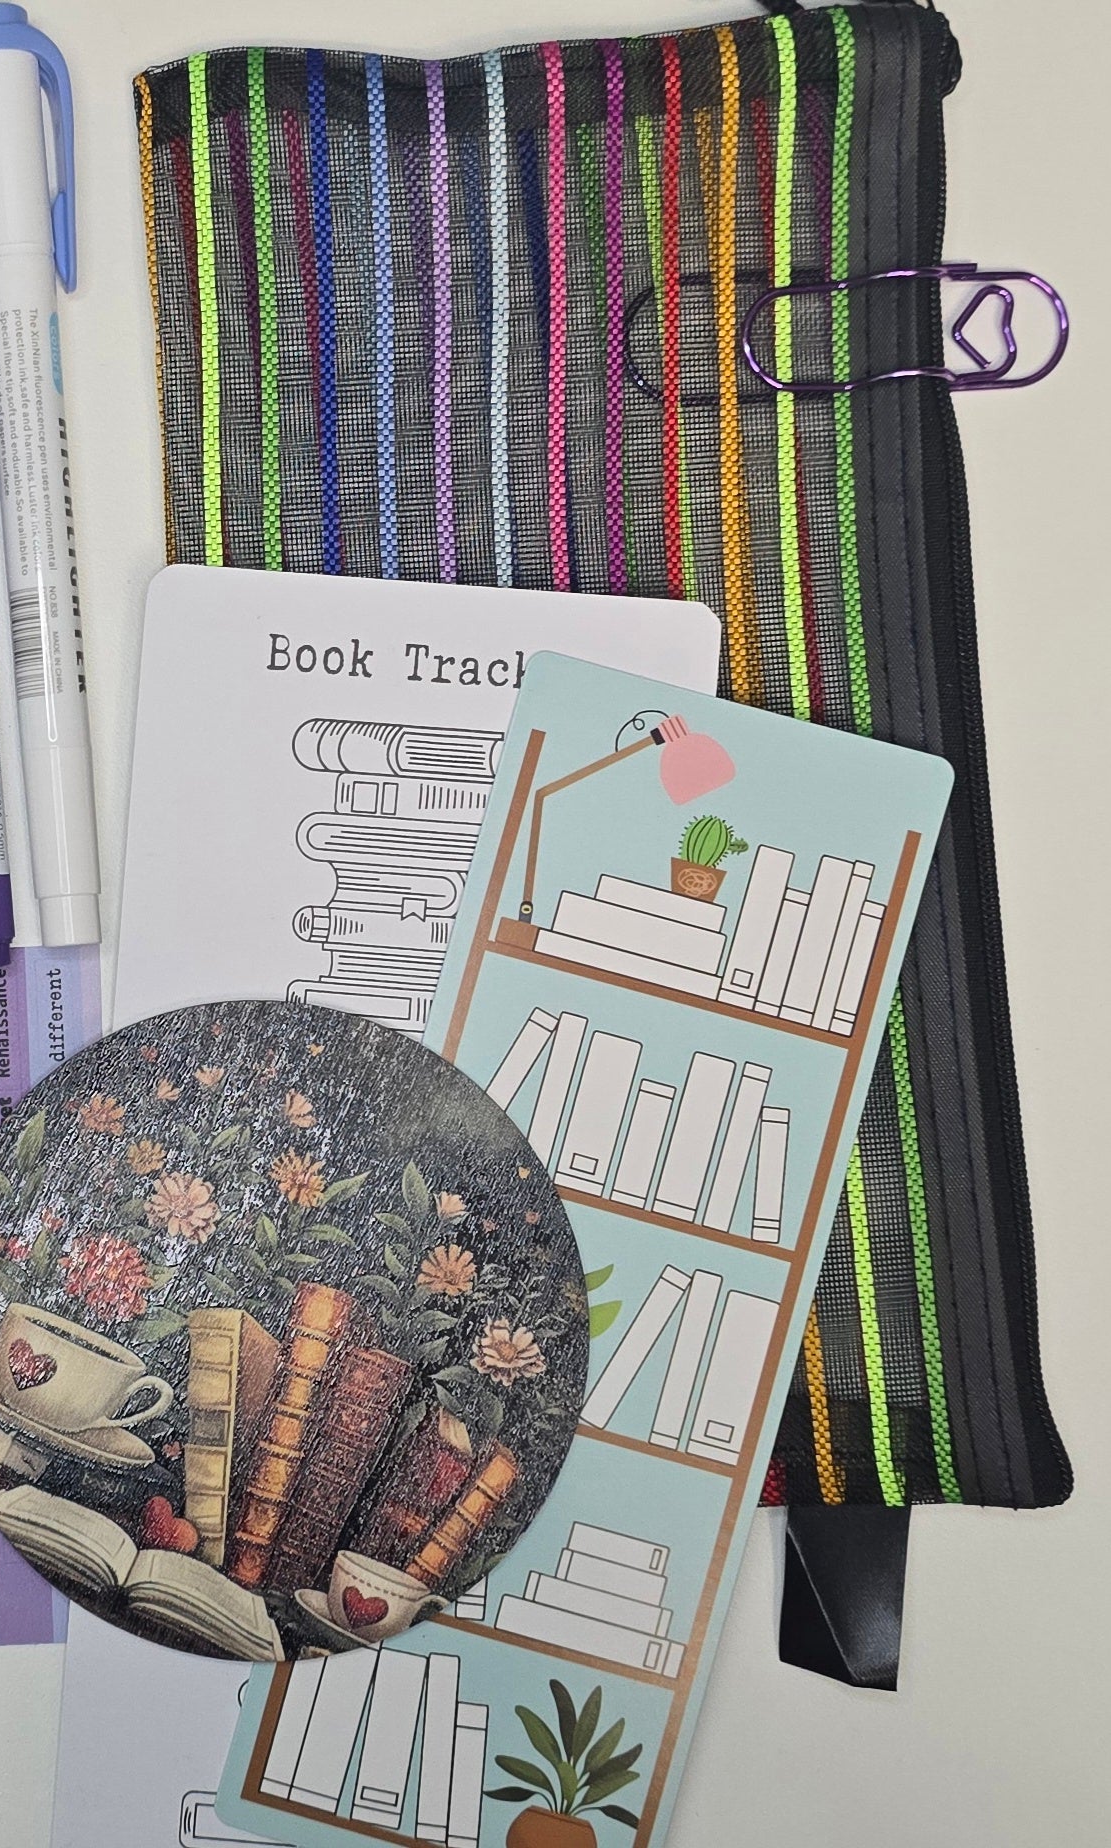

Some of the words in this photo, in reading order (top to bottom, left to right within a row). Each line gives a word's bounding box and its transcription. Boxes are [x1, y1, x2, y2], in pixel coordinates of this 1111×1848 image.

[0, 310, 11, 350] Special
[28, 308, 38, 328] The
[4, 352, 13, 376] fibre
[31, 330, 41, 372] XinNian
[11, 309, 28, 365] protection
[22, 412, 32, 432] and
[34, 375, 46, 443] fluorescence
[8, 420, 17, 440] and
[37, 445, 49, 465] pen
[41, 468, 50, 491] uses
[16, 515, 28, 562] available
[44, 494, 57, 571] environmental
[20, 564, 29, 576] to
[52, 631, 61, 655] MADE
[266, 633, 374, 678] Book
[405, 643, 525, 689] Track
[55, 668, 64, 694] CHINA
[47, 968, 66, 1062] different
